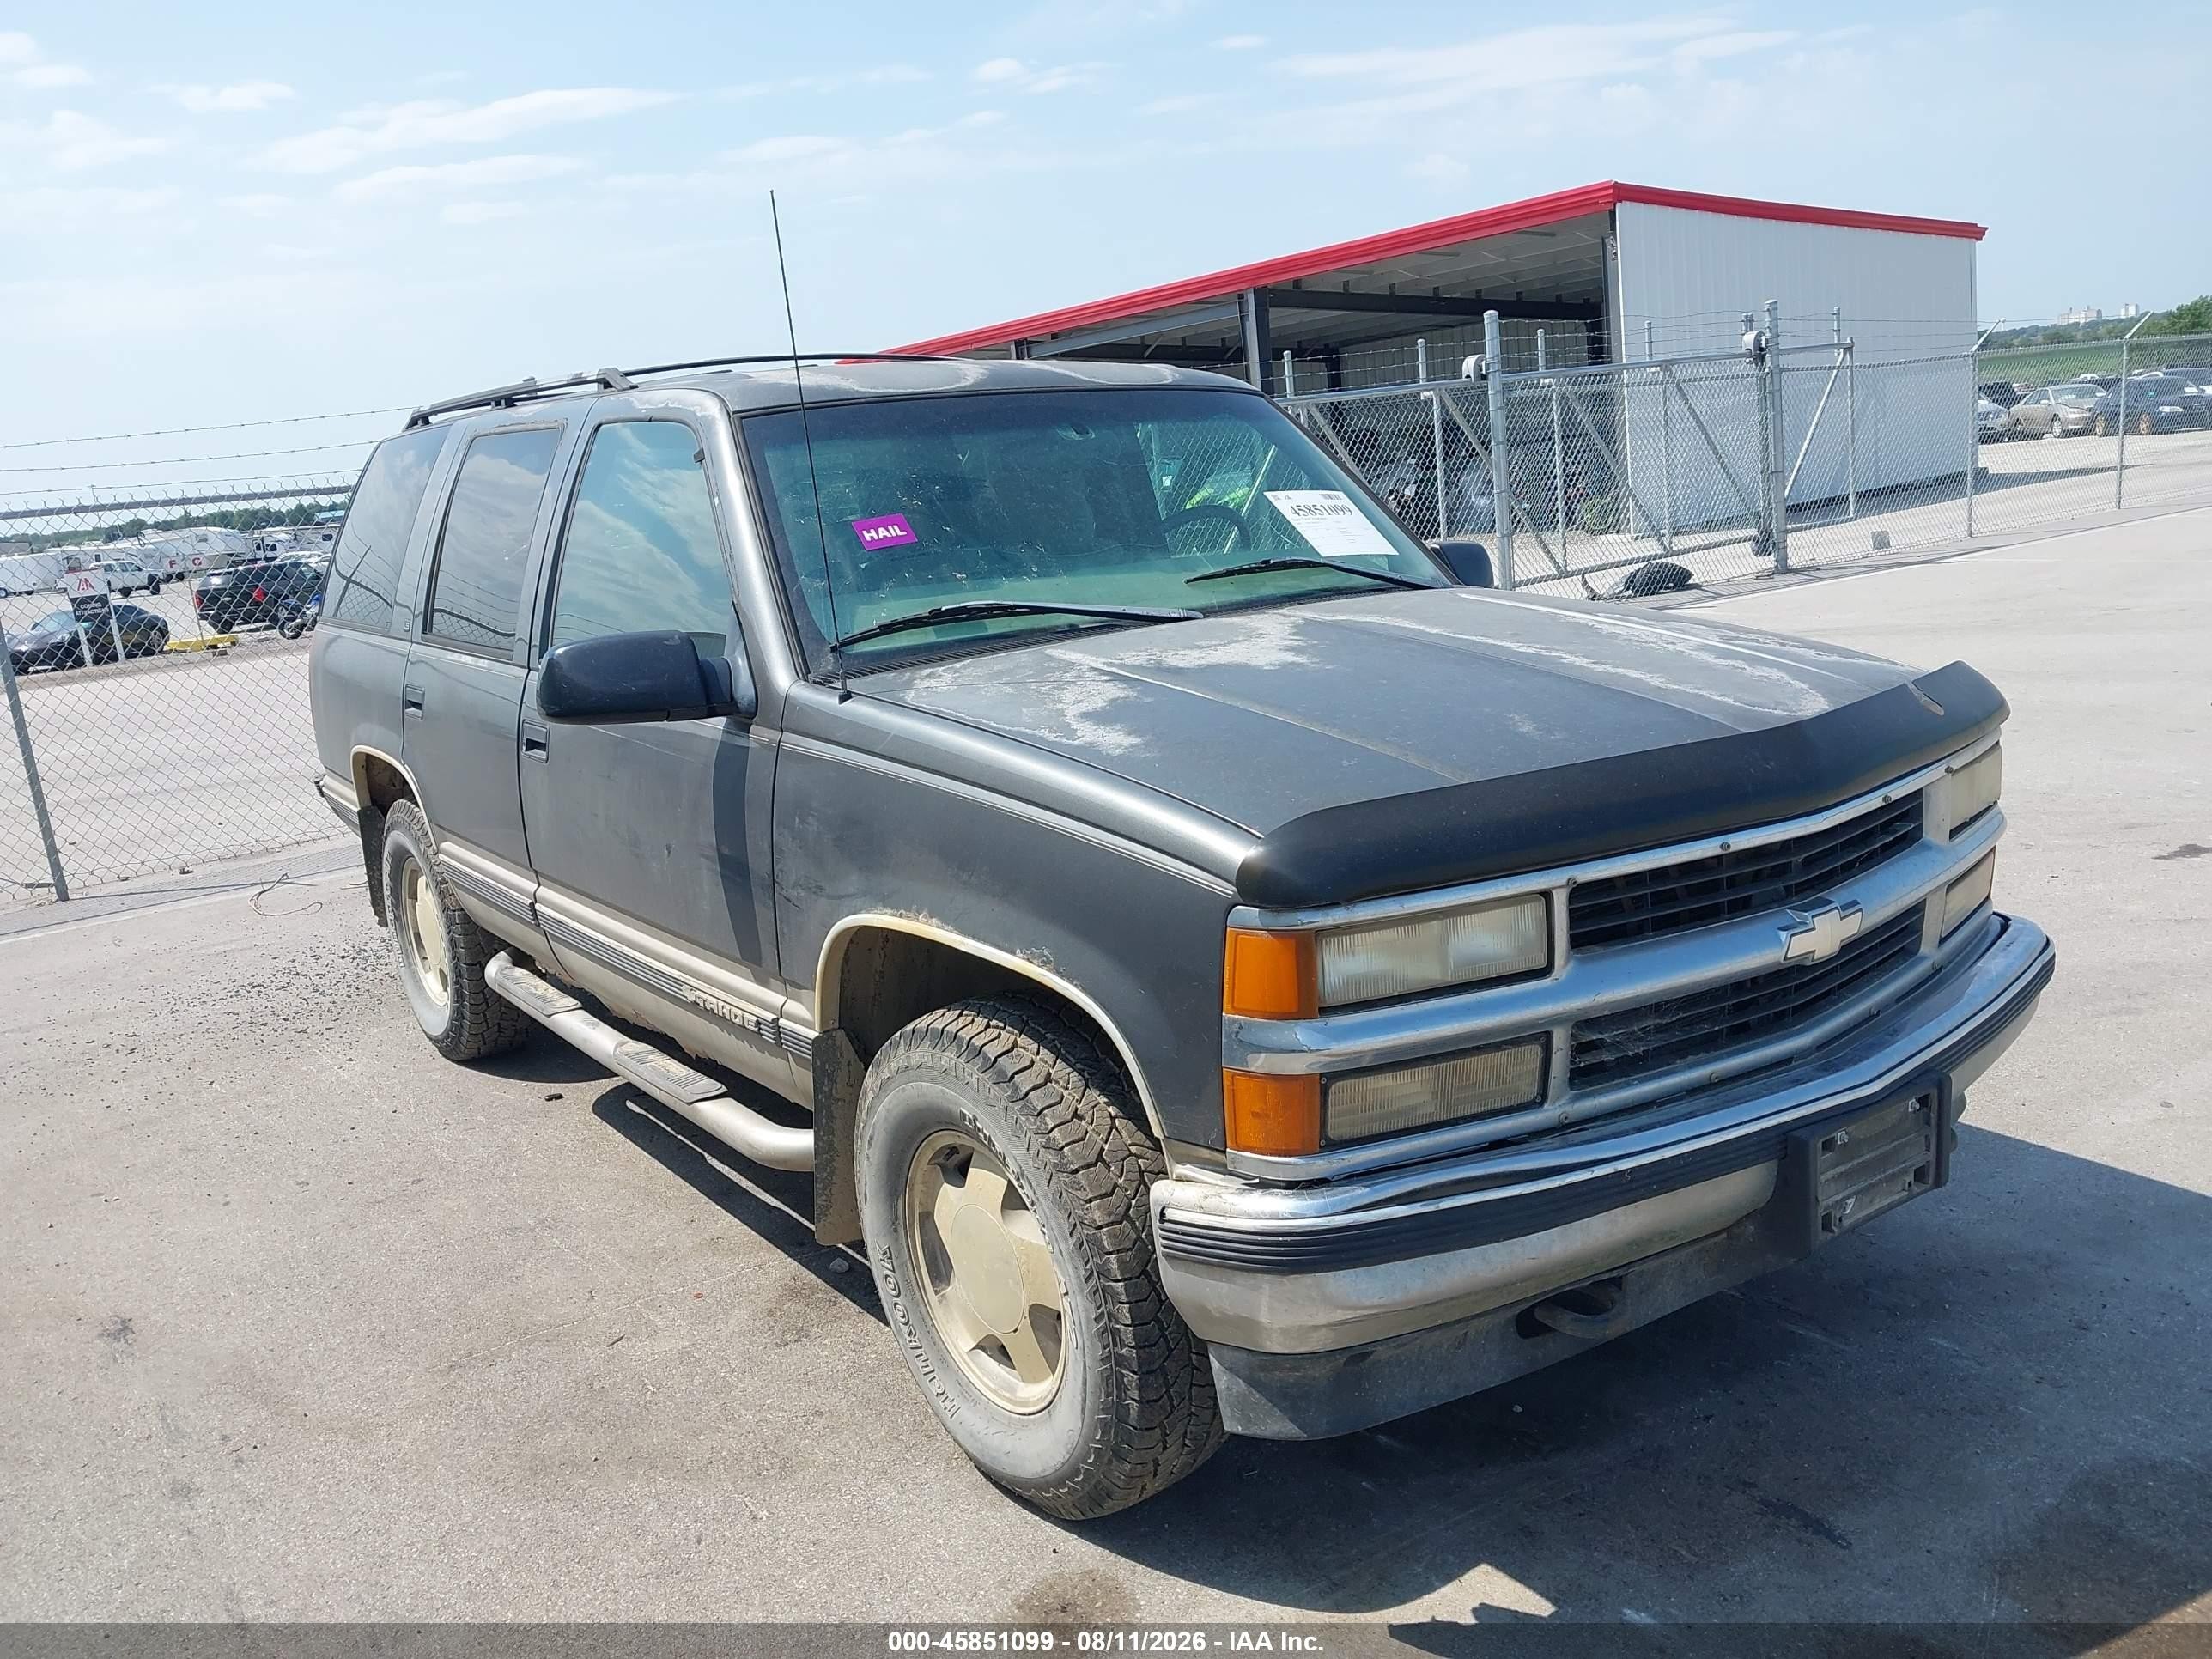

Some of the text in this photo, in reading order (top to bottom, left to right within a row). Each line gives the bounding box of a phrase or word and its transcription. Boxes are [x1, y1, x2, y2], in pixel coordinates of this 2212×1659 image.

[1290, 504, 1353, 517] 45851099
[861, 525, 908, 542] HAIL
[168, 559, 177, 568] F
[694, 991, 758, 1033] TAHOE
